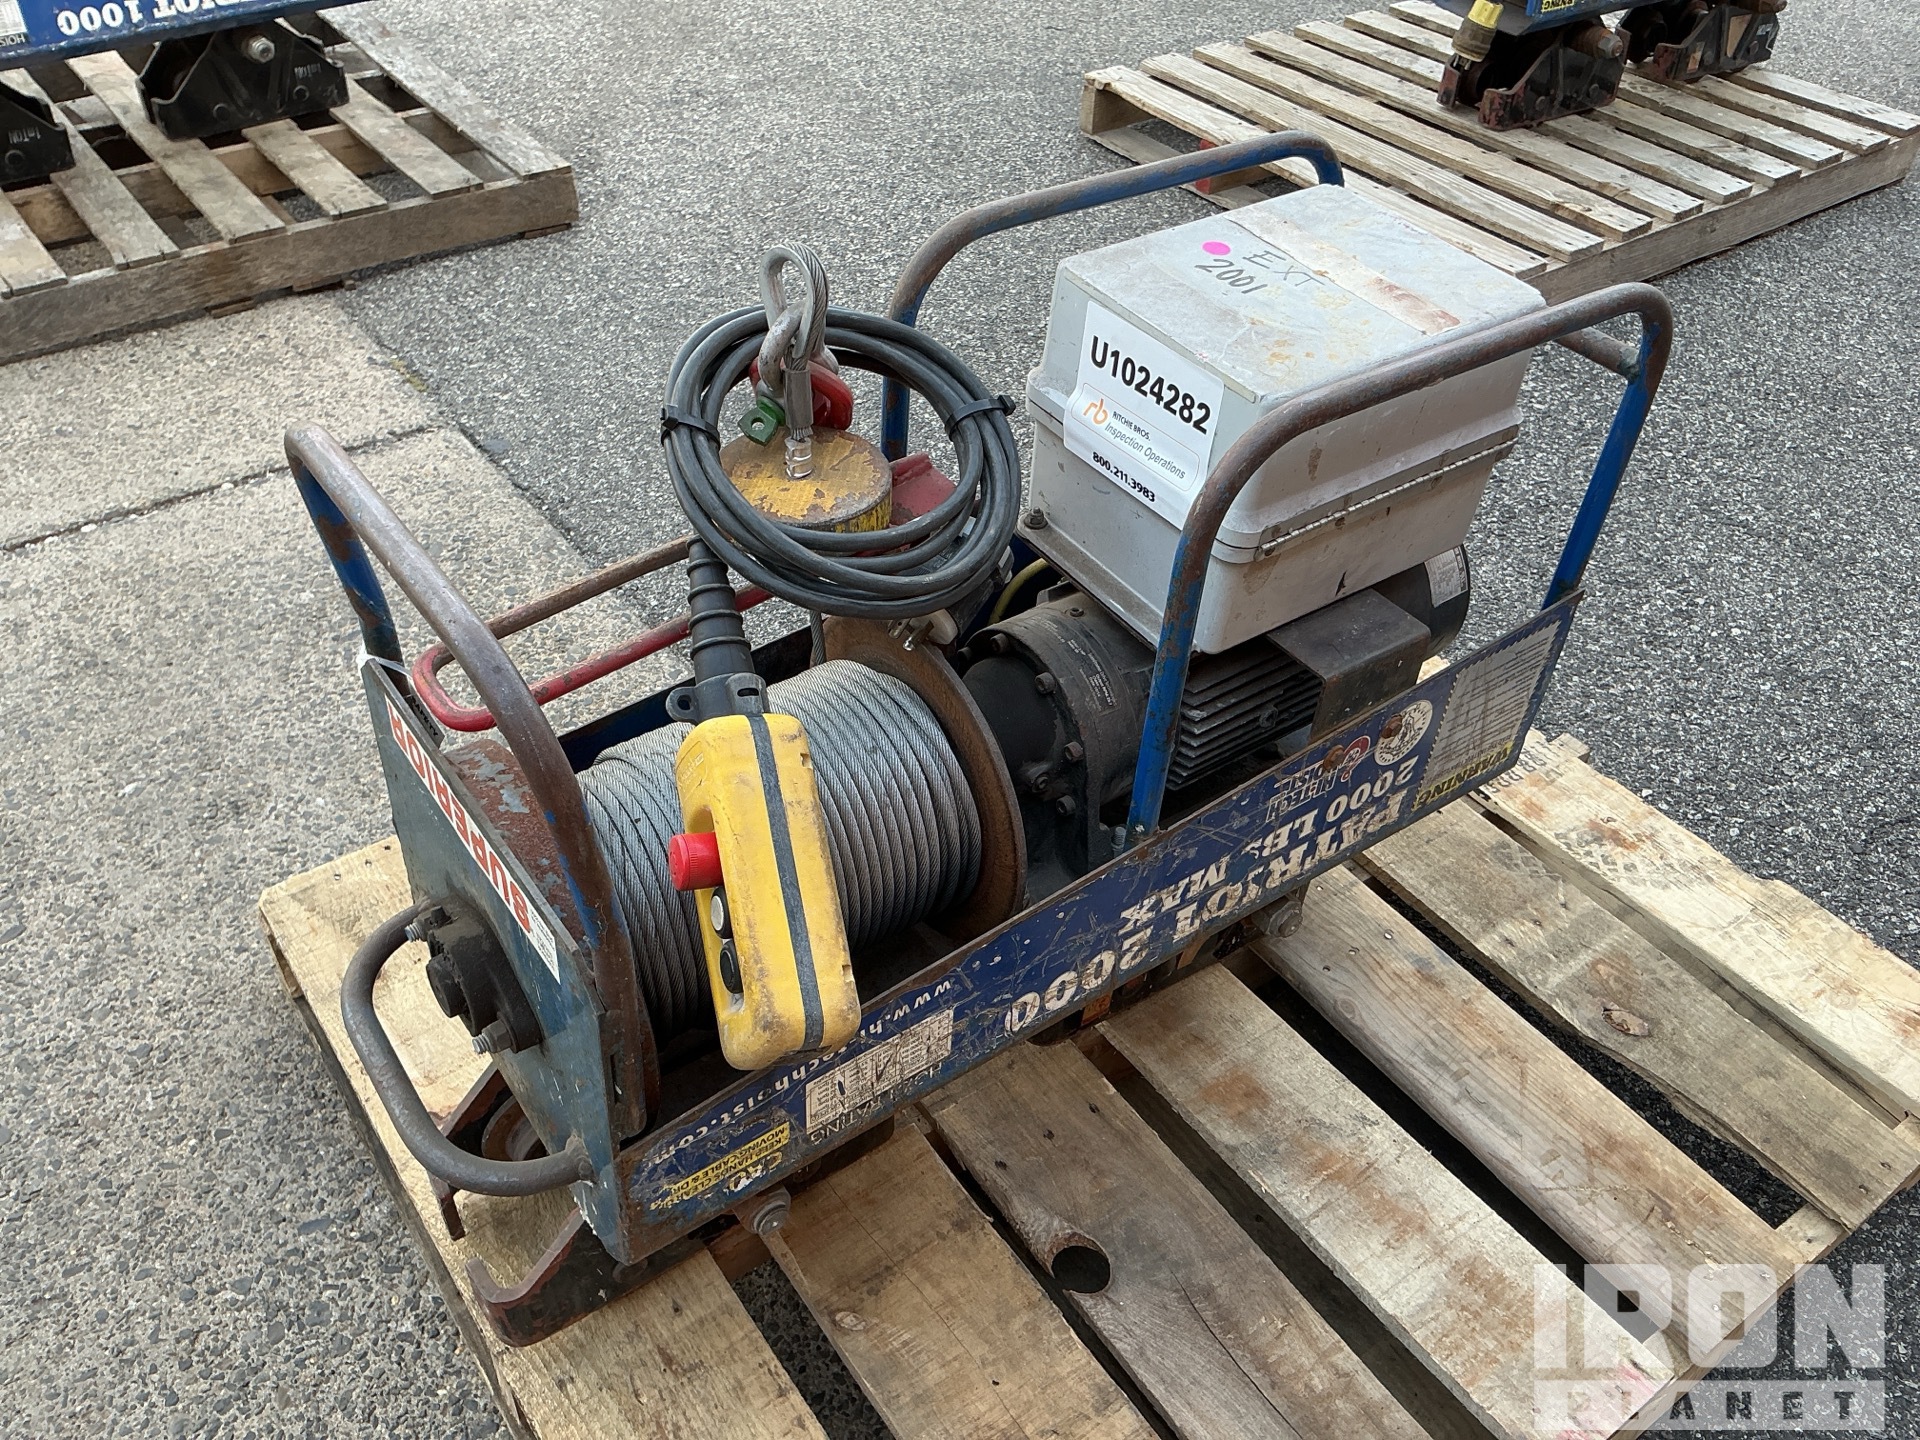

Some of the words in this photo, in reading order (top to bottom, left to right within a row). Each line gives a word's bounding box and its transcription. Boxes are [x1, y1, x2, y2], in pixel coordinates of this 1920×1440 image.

[57, 0, 143, 36] 1000
[1194, 258, 1268, 294] 2001
[1243, 250, 1325, 287] EXT
[1090, 335, 1211, 435] U1024282
[1104, 422, 1144, 453] Inspection
[1143, 447, 1186, 479] Operations
[1112, 410, 1134, 430] RITCHIE
[1133, 424, 1151, 441] BROS.
[1092, 451, 1156, 503] 800.211.3983
[1326, 755, 1419, 822] 2000
[1417, 746, 1510, 808] WARNING
[387, 699, 531, 934] SUPERIOR
[1173, 787, 1409, 943] PATRIOT
[1117, 853, 1231, 937] MAX
[1003, 925, 1155, 1038] 2000
[702, 1156, 740, 1178] CABLE
[714, 1153, 755, 1178] HANDS
[740, 1128, 785, 1157] MOVING
[756, 1137, 782, 1157] KEEP
